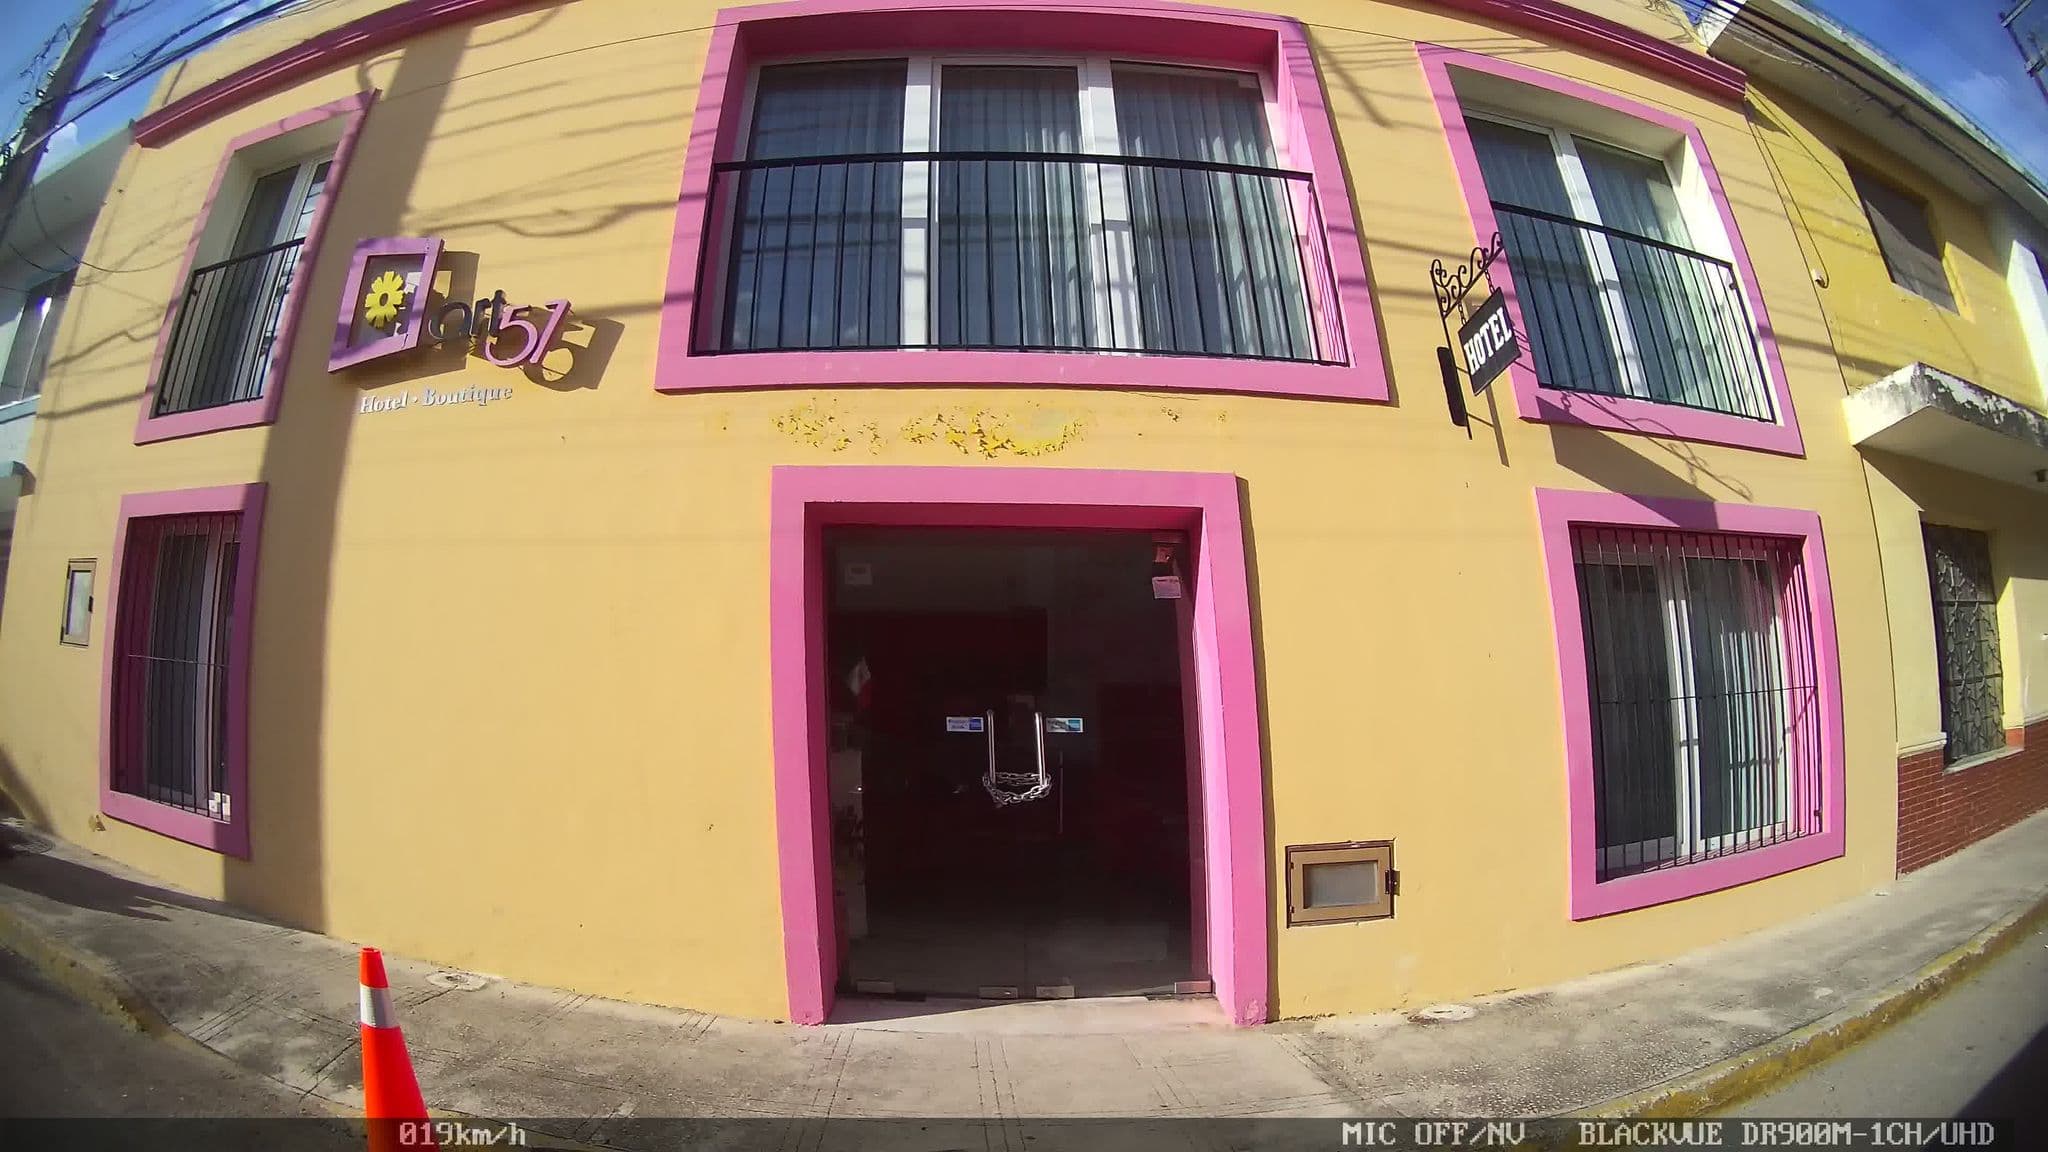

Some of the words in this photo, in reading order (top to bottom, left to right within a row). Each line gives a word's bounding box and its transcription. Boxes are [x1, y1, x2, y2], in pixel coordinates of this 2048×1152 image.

[1463, 307, 1512, 375] HOTEL
[359, 390, 408, 414] Hotel
[422, 384, 513, 408] Boutique
